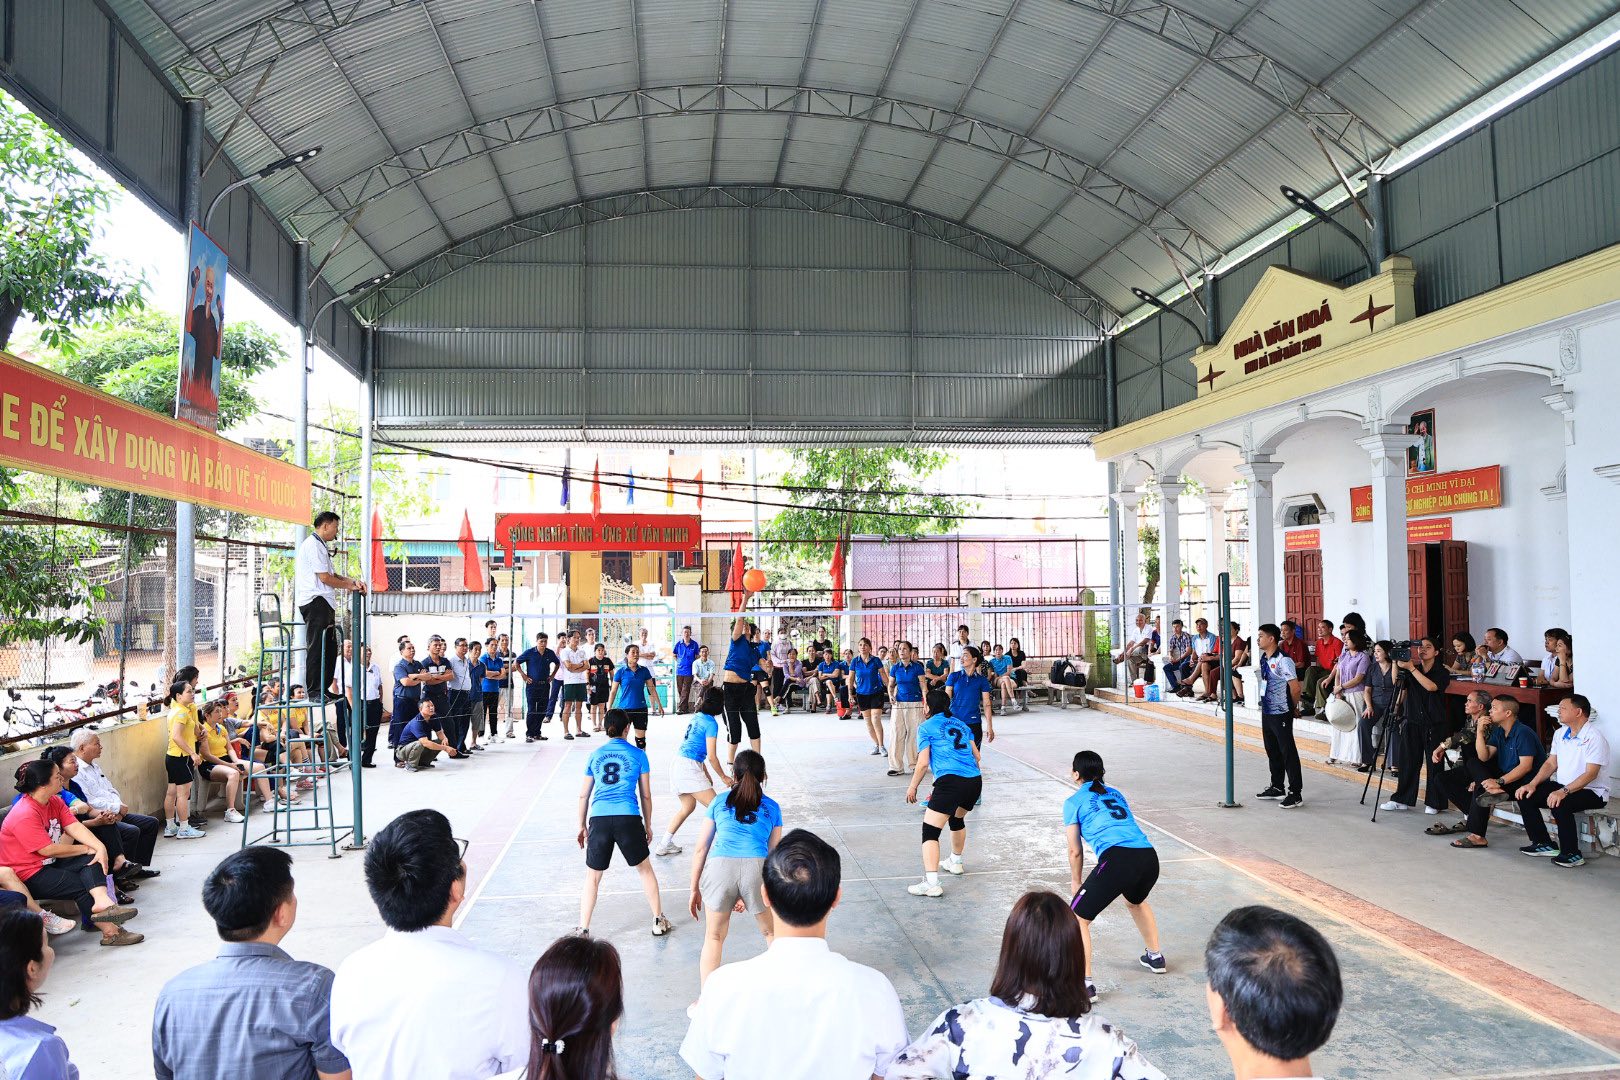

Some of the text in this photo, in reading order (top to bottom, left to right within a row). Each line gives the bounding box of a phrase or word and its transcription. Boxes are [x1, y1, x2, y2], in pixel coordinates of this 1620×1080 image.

[1234, 331, 1264, 360] NHÀ
[1264, 320, 1295, 347] VĂN
[1297, 298, 1332, 333] HOÁ
[0, 392, 20, 441] E
[30, 394, 68, 452] ĐỂ
[73, 416, 119, 465] XÂY
[125, 432, 176, 481] DỰNG
[180, 449, 201, 485] VÀ
[204, 450, 232, 493] BẢO
[235, 466, 251, 504] VỆ
[270, 472, 297, 508] QUỐC
[1426, 481, 1447, 493] MINH
[1460, 476, 1475, 492] ĐẠI
[1355, 503, 1371, 517] SỐNG
[1438, 490, 1453, 507] CỦA
[1454, 489, 1478, 505] CHÚNG
[1479, 490, 1489, 501] TA
[507, 521, 535, 543] SỐNG
[537, 523, 569, 543] NGHĨA
[570, 523, 593, 543] TÌNH
[601, 523, 622, 543] ỨNG
[624, 521, 638, 543] XỬ
[641, 524, 660, 543] VĂN
[662, 526, 689, 543] MINH
[948, 727, 968, 751] 2
[601, 762, 621, 785] 8
[1101, 798, 1128, 820] 5
